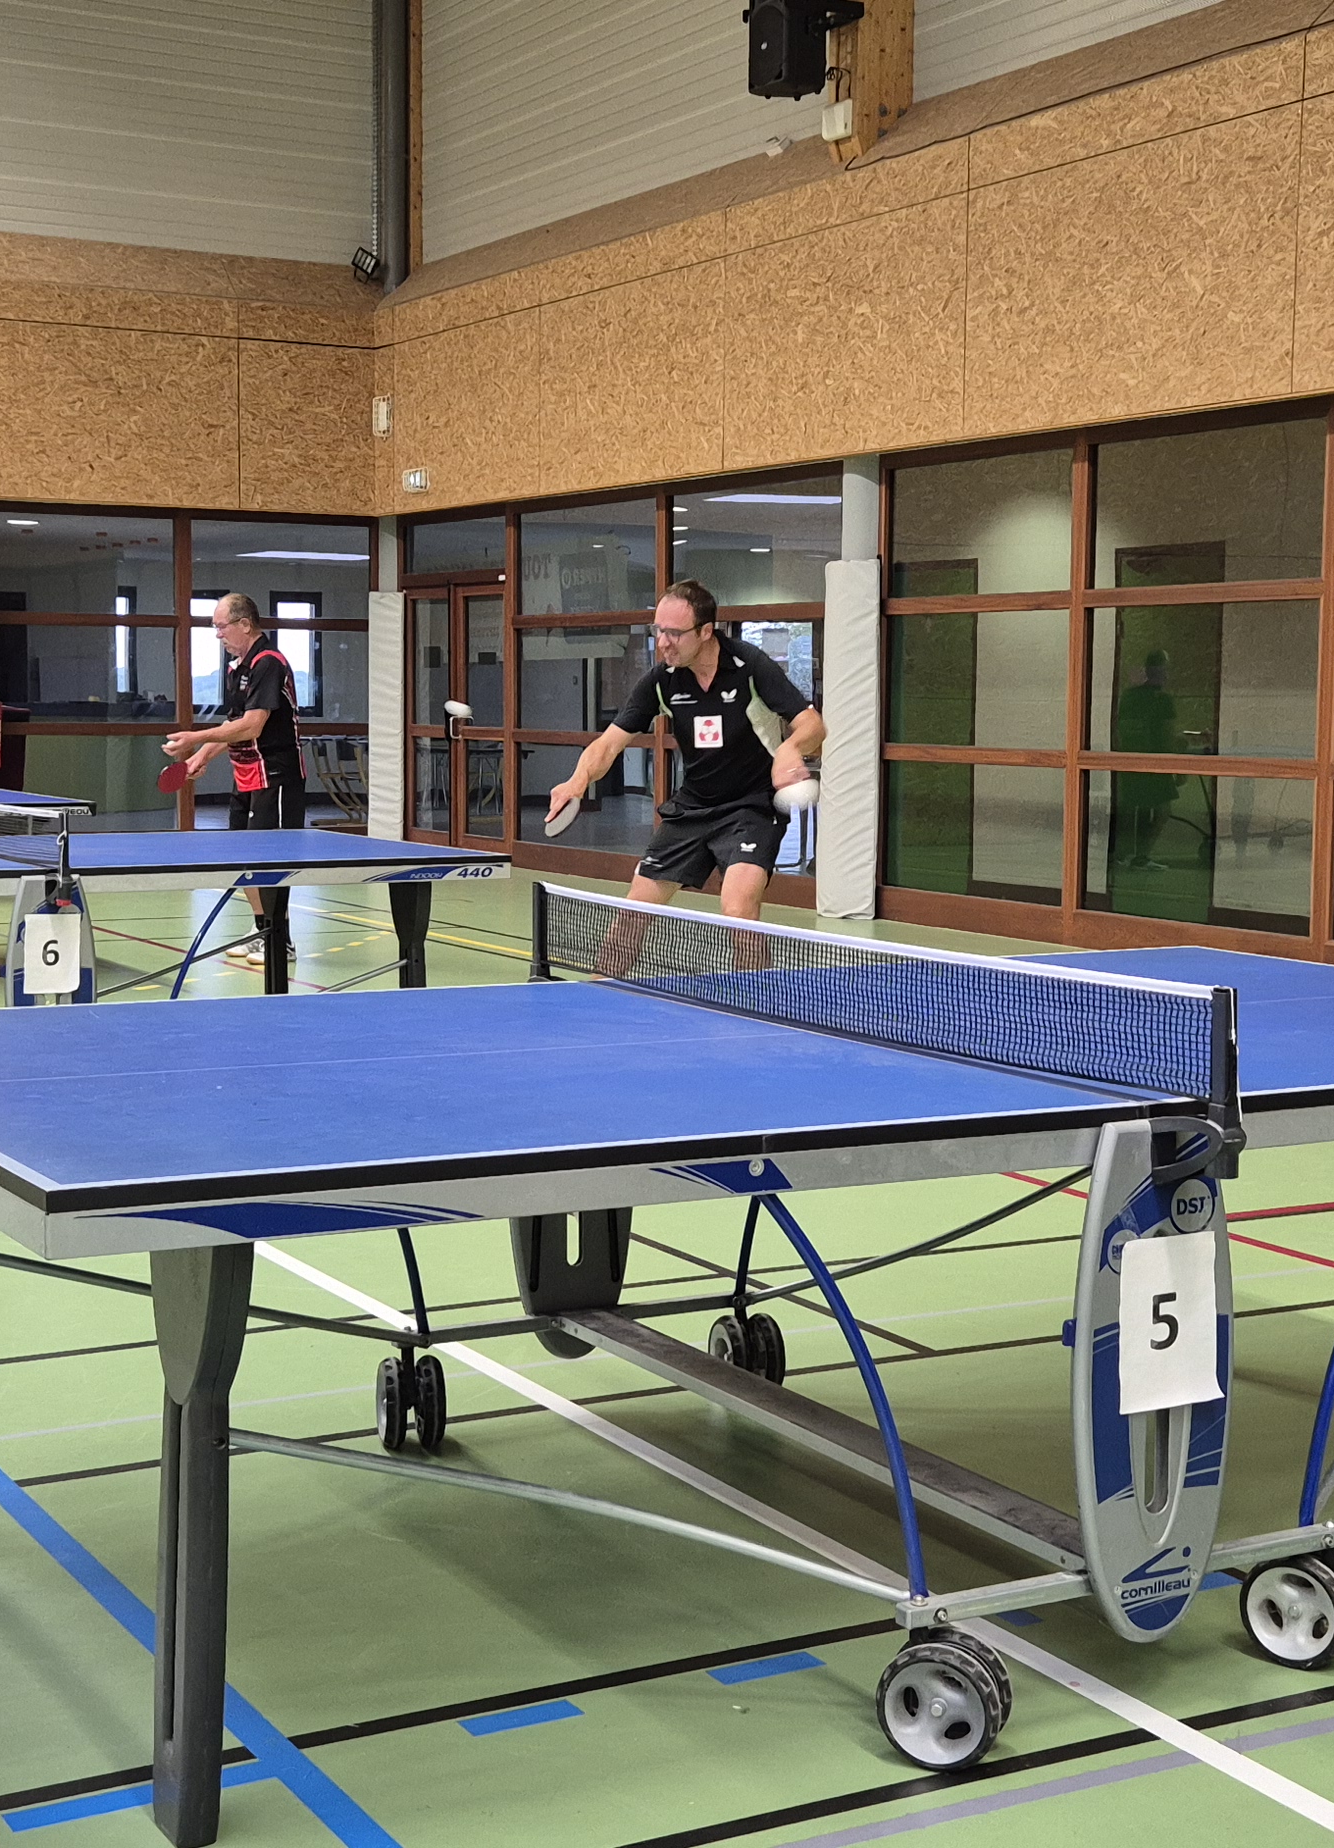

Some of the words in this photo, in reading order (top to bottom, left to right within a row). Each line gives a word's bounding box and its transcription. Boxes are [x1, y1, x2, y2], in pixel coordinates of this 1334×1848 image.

[457, 866, 493, 878] 440
[42, 939, 60, 966] 6
[1149, 1291, 1179, 1351] 5
